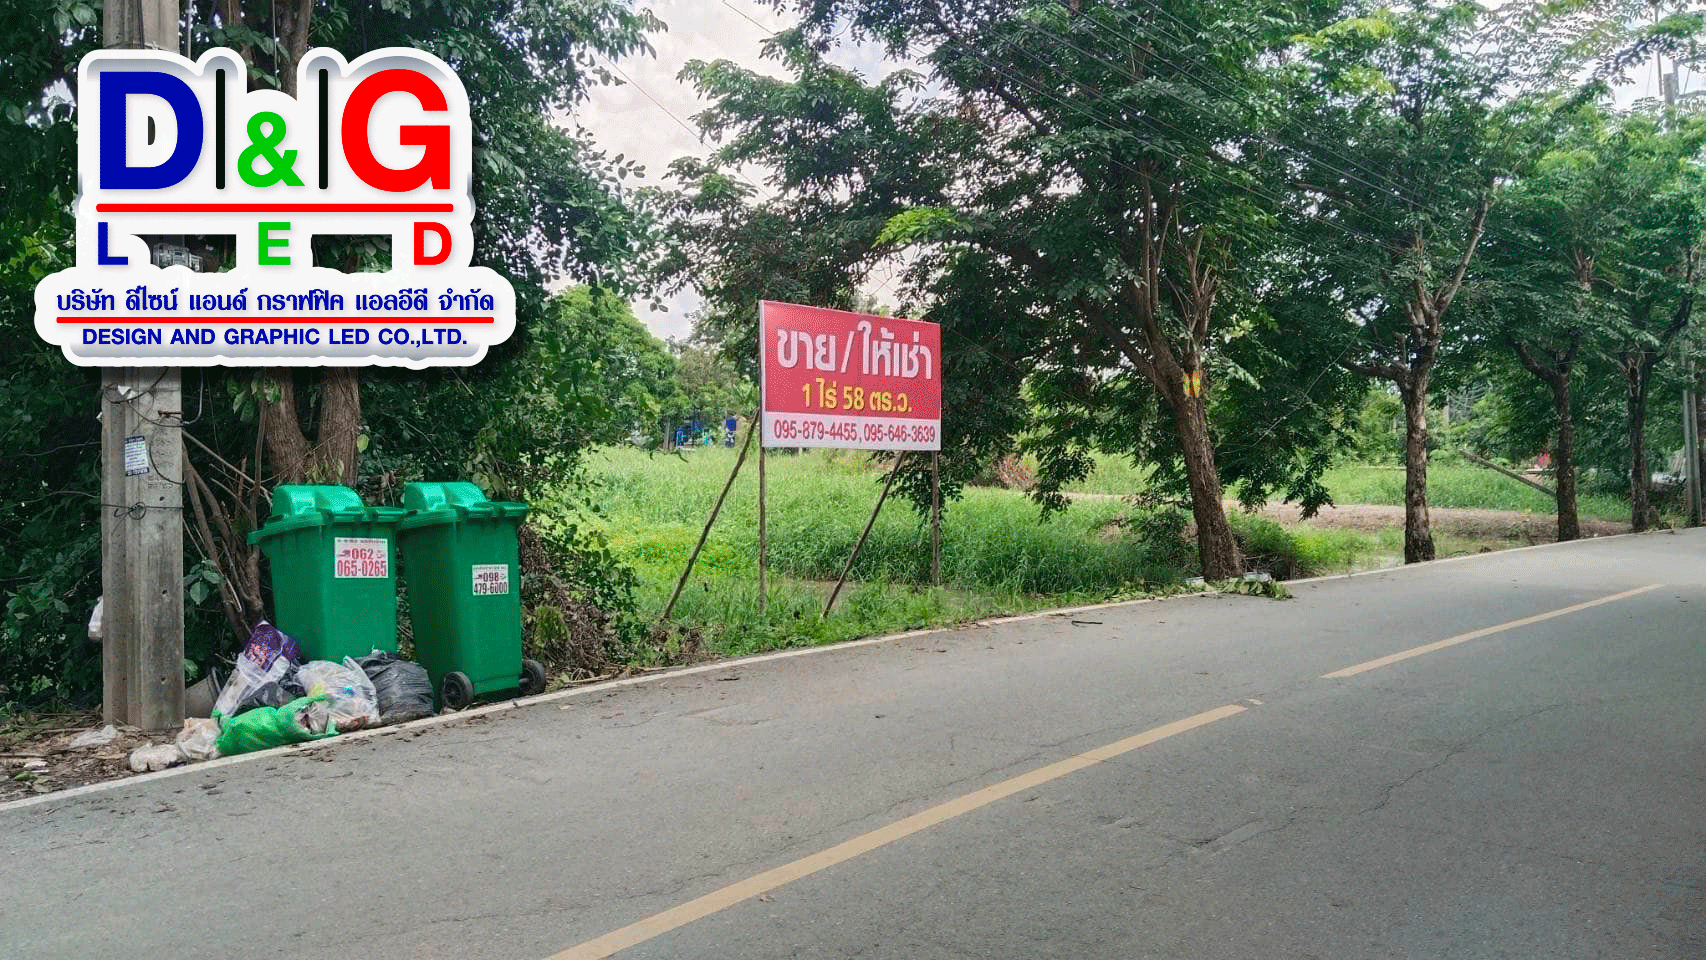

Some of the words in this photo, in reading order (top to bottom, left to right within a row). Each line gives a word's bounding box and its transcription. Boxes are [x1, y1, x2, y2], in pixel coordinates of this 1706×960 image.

[802, 383, 811, 407] 1
[815, 377, 838, 409] ไร่
[842, 385, 865, 410] 58
[869, 391, 912, 412] ตร.ว.
[351, 548, 374, 560] 062
[337, 560, 387, 577] 065-0265
[483, 572, 499, 582] 098
